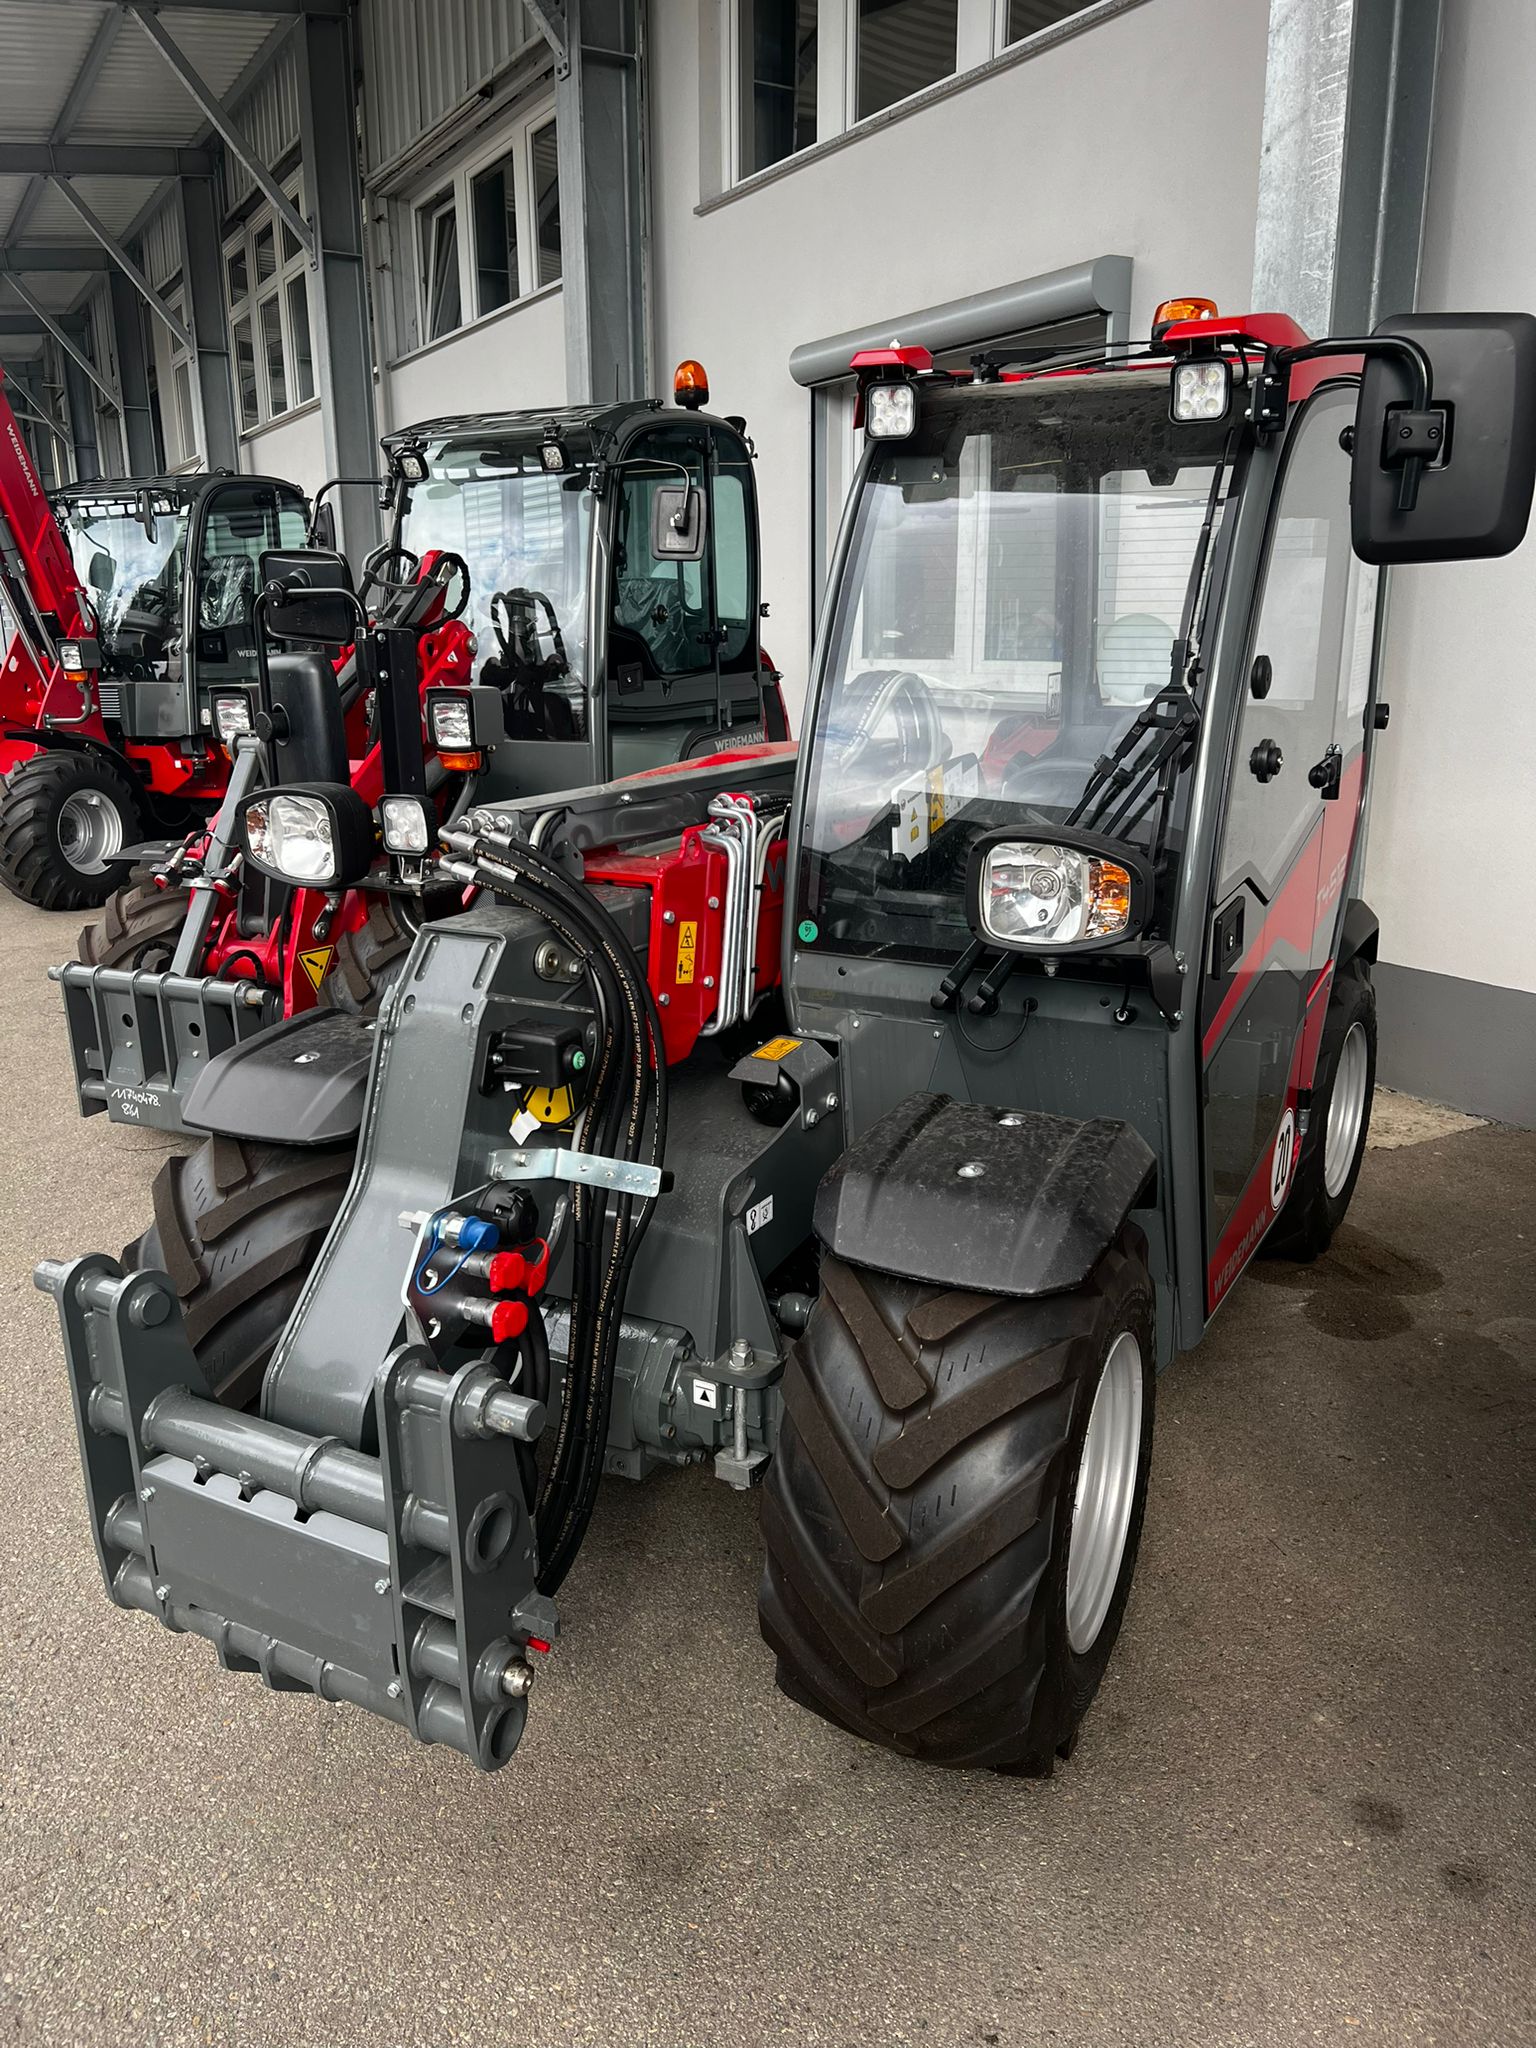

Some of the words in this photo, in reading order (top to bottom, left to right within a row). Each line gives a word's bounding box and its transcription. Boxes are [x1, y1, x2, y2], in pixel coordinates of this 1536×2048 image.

[7, 423, 39, 497] WEIDEMANN
[237, 649, 282, 658] WEIDANN
[714, 730, 766, 752] WEIDEMANN
[1273, 1124, 1291, 1197] 20
[1213, 1205, 1267, 1297] WEIDEMANN
